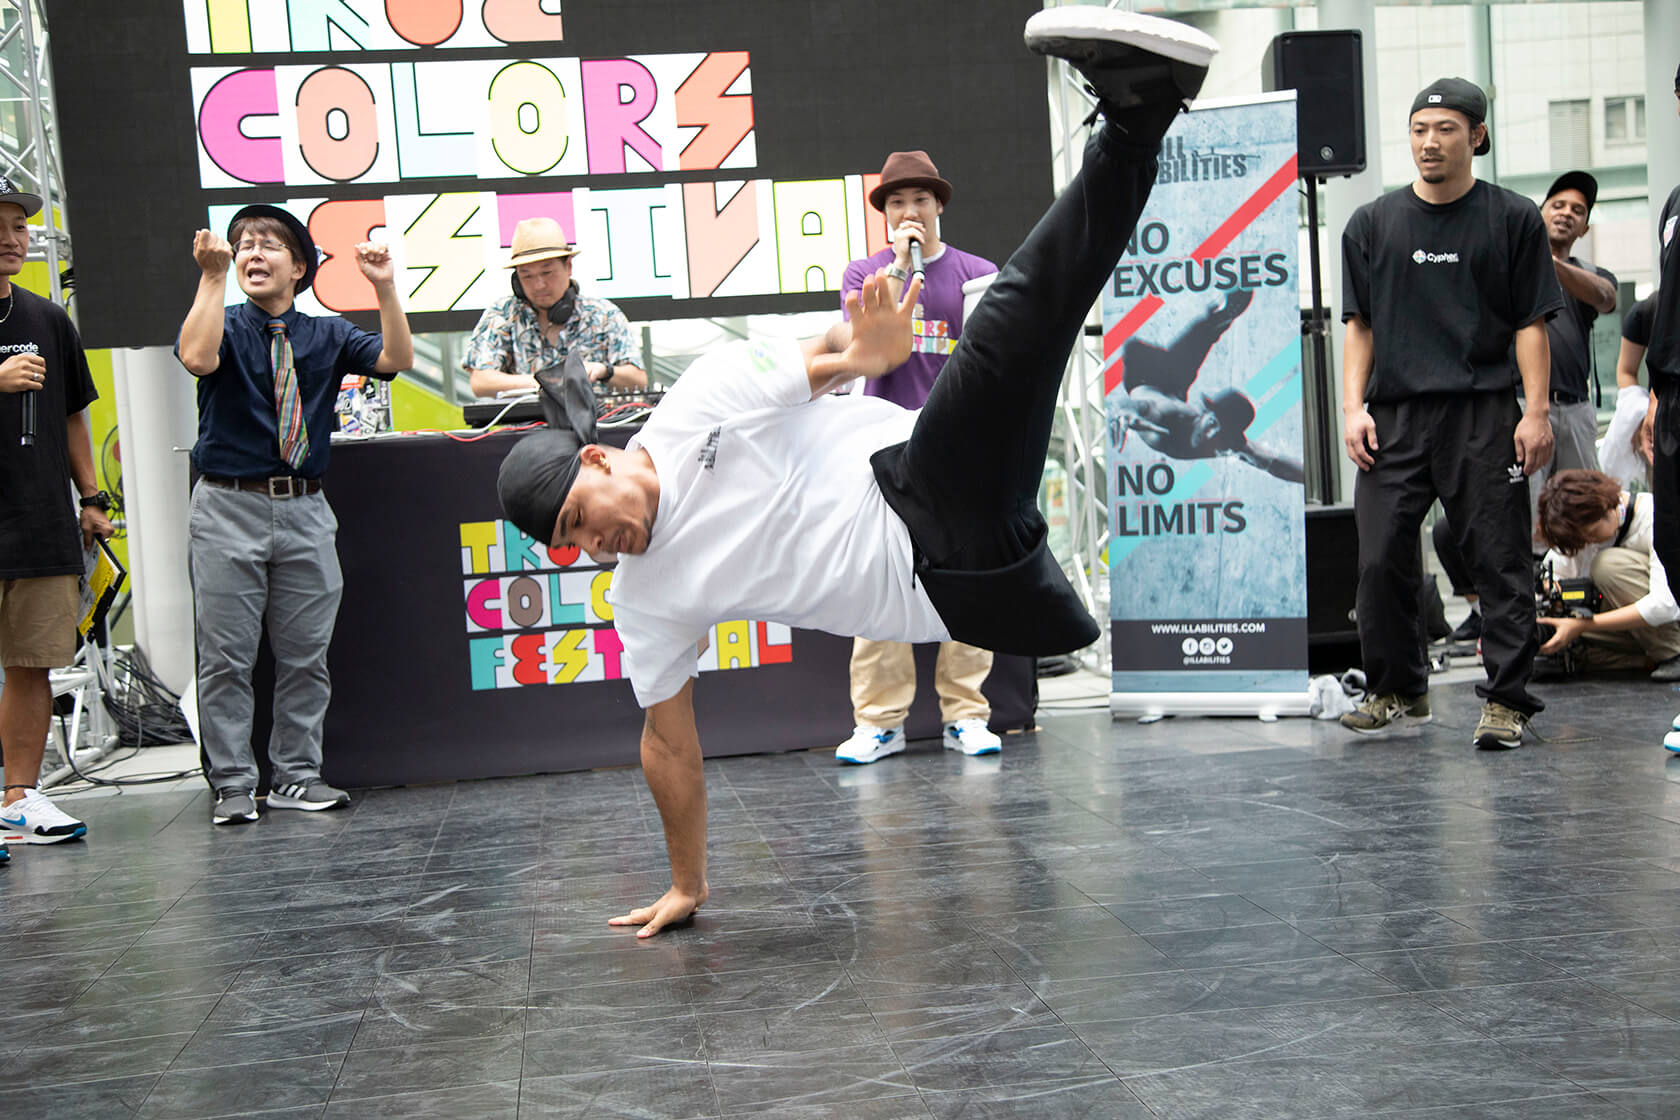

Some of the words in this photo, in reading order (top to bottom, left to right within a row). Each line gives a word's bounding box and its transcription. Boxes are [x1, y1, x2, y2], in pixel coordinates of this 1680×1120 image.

[199, 51, 754, 185] COLORS
[1156, 154, 1247, 185] BILITIES
[1114, 254, 1288, 298] EXCUSES
[913, 320, 949, 337] ORS
[0, 341, 39, 353] ercode
[1118, 463, 1175, 496] NO
[1119, 502, 1247, 537] LIMITS
[466, 571, 615, 630] COLO
[1151, 622, 1266, 634] WWW.ILLABILITIES.COM
[469, 619, 793, 690] FESTAL
